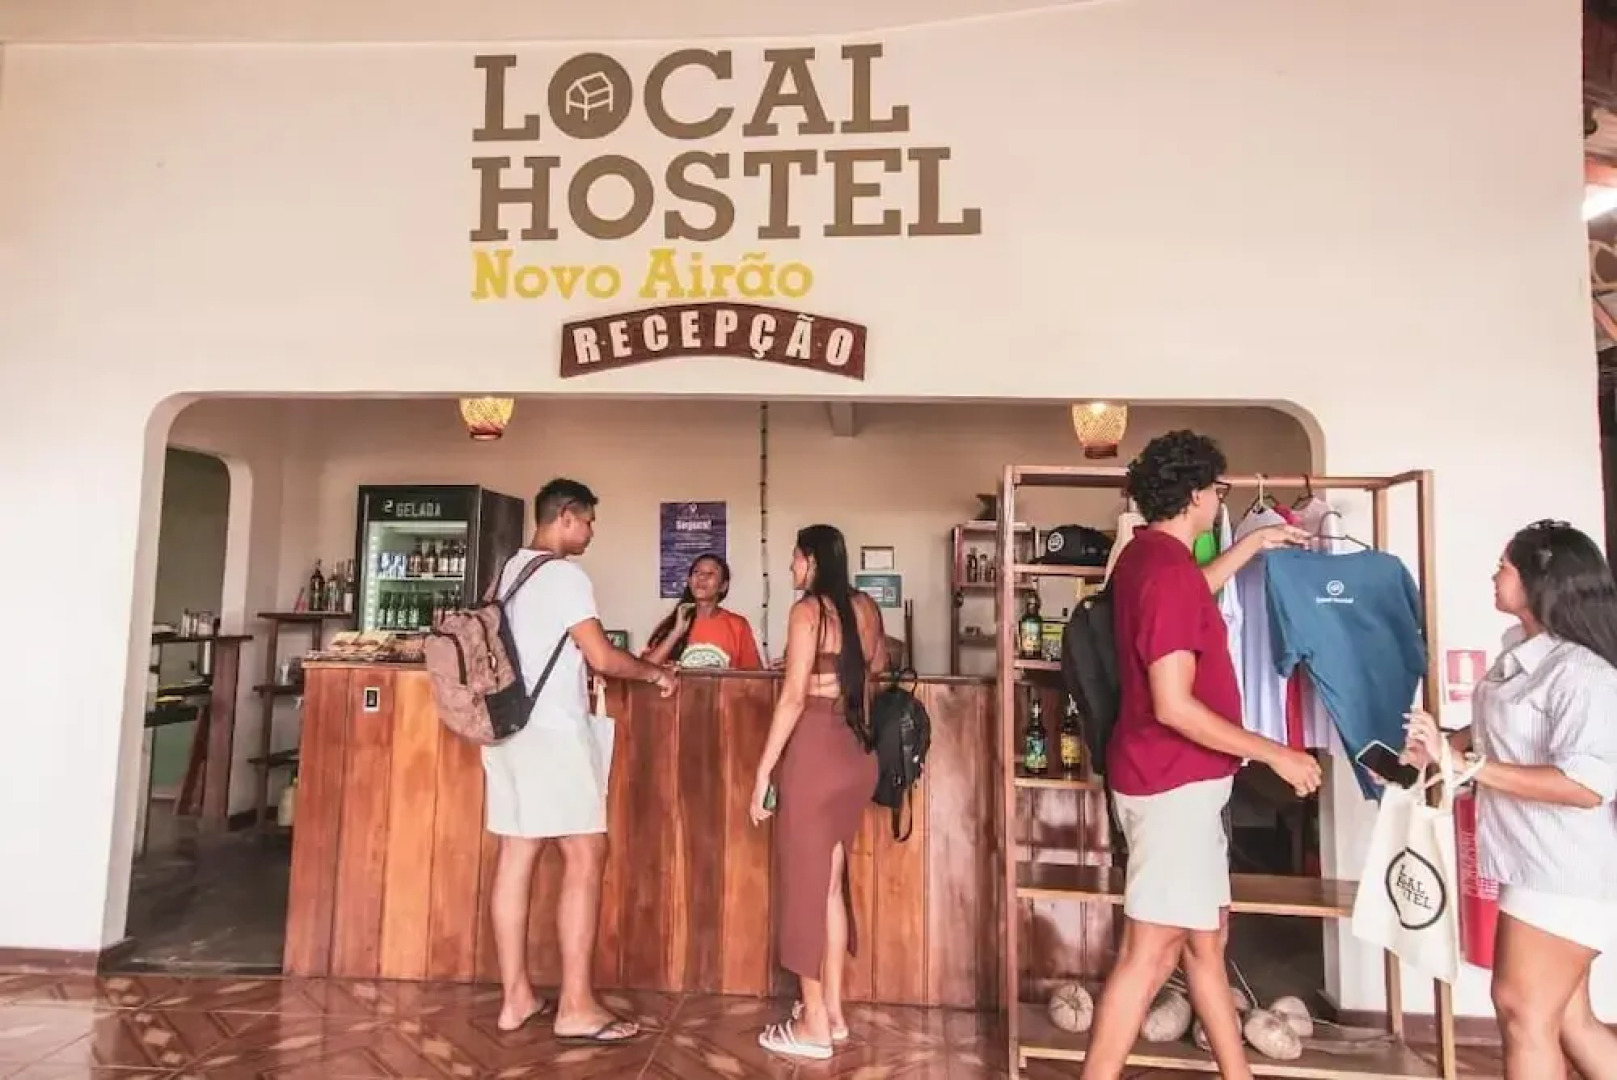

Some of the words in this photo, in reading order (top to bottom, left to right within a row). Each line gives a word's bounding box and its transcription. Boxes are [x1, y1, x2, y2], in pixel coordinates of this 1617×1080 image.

[472, 43, 910, 142] LOCAL
[470, 146, 982, 242] HOSTEL
[470, 249, 622, 300] Novo
[638, 248, 814, 300] Airão
[571, 308, 855, 367] RECEPÇÃO
[395, 502, 441, 518] GELADA
